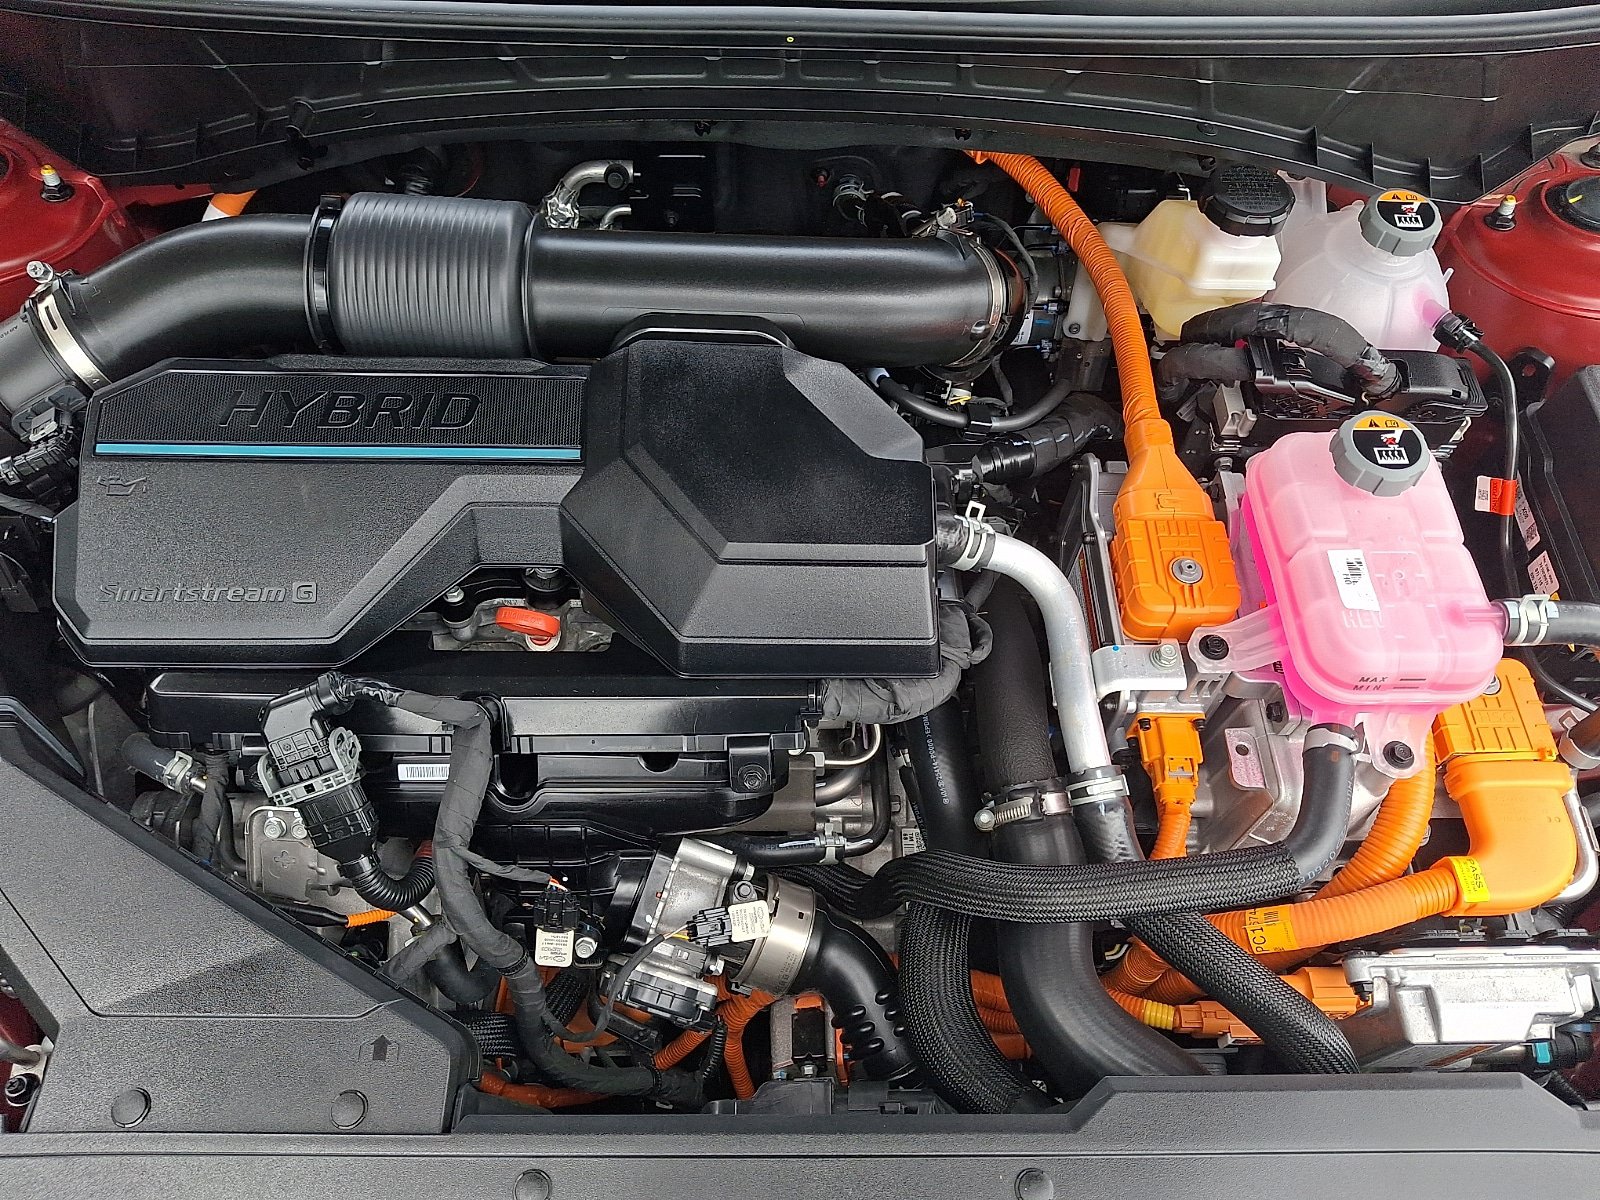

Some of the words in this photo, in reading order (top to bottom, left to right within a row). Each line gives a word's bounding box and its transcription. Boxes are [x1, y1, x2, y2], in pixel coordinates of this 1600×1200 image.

[218, 389, 482, 430] HYBRID
[96, 582, 287, 603] Smartstream
[294, 582, 316, 603] G
[1465, 858, 1484, 889] PASS
[1248, 926, 1270, 954] PC1
